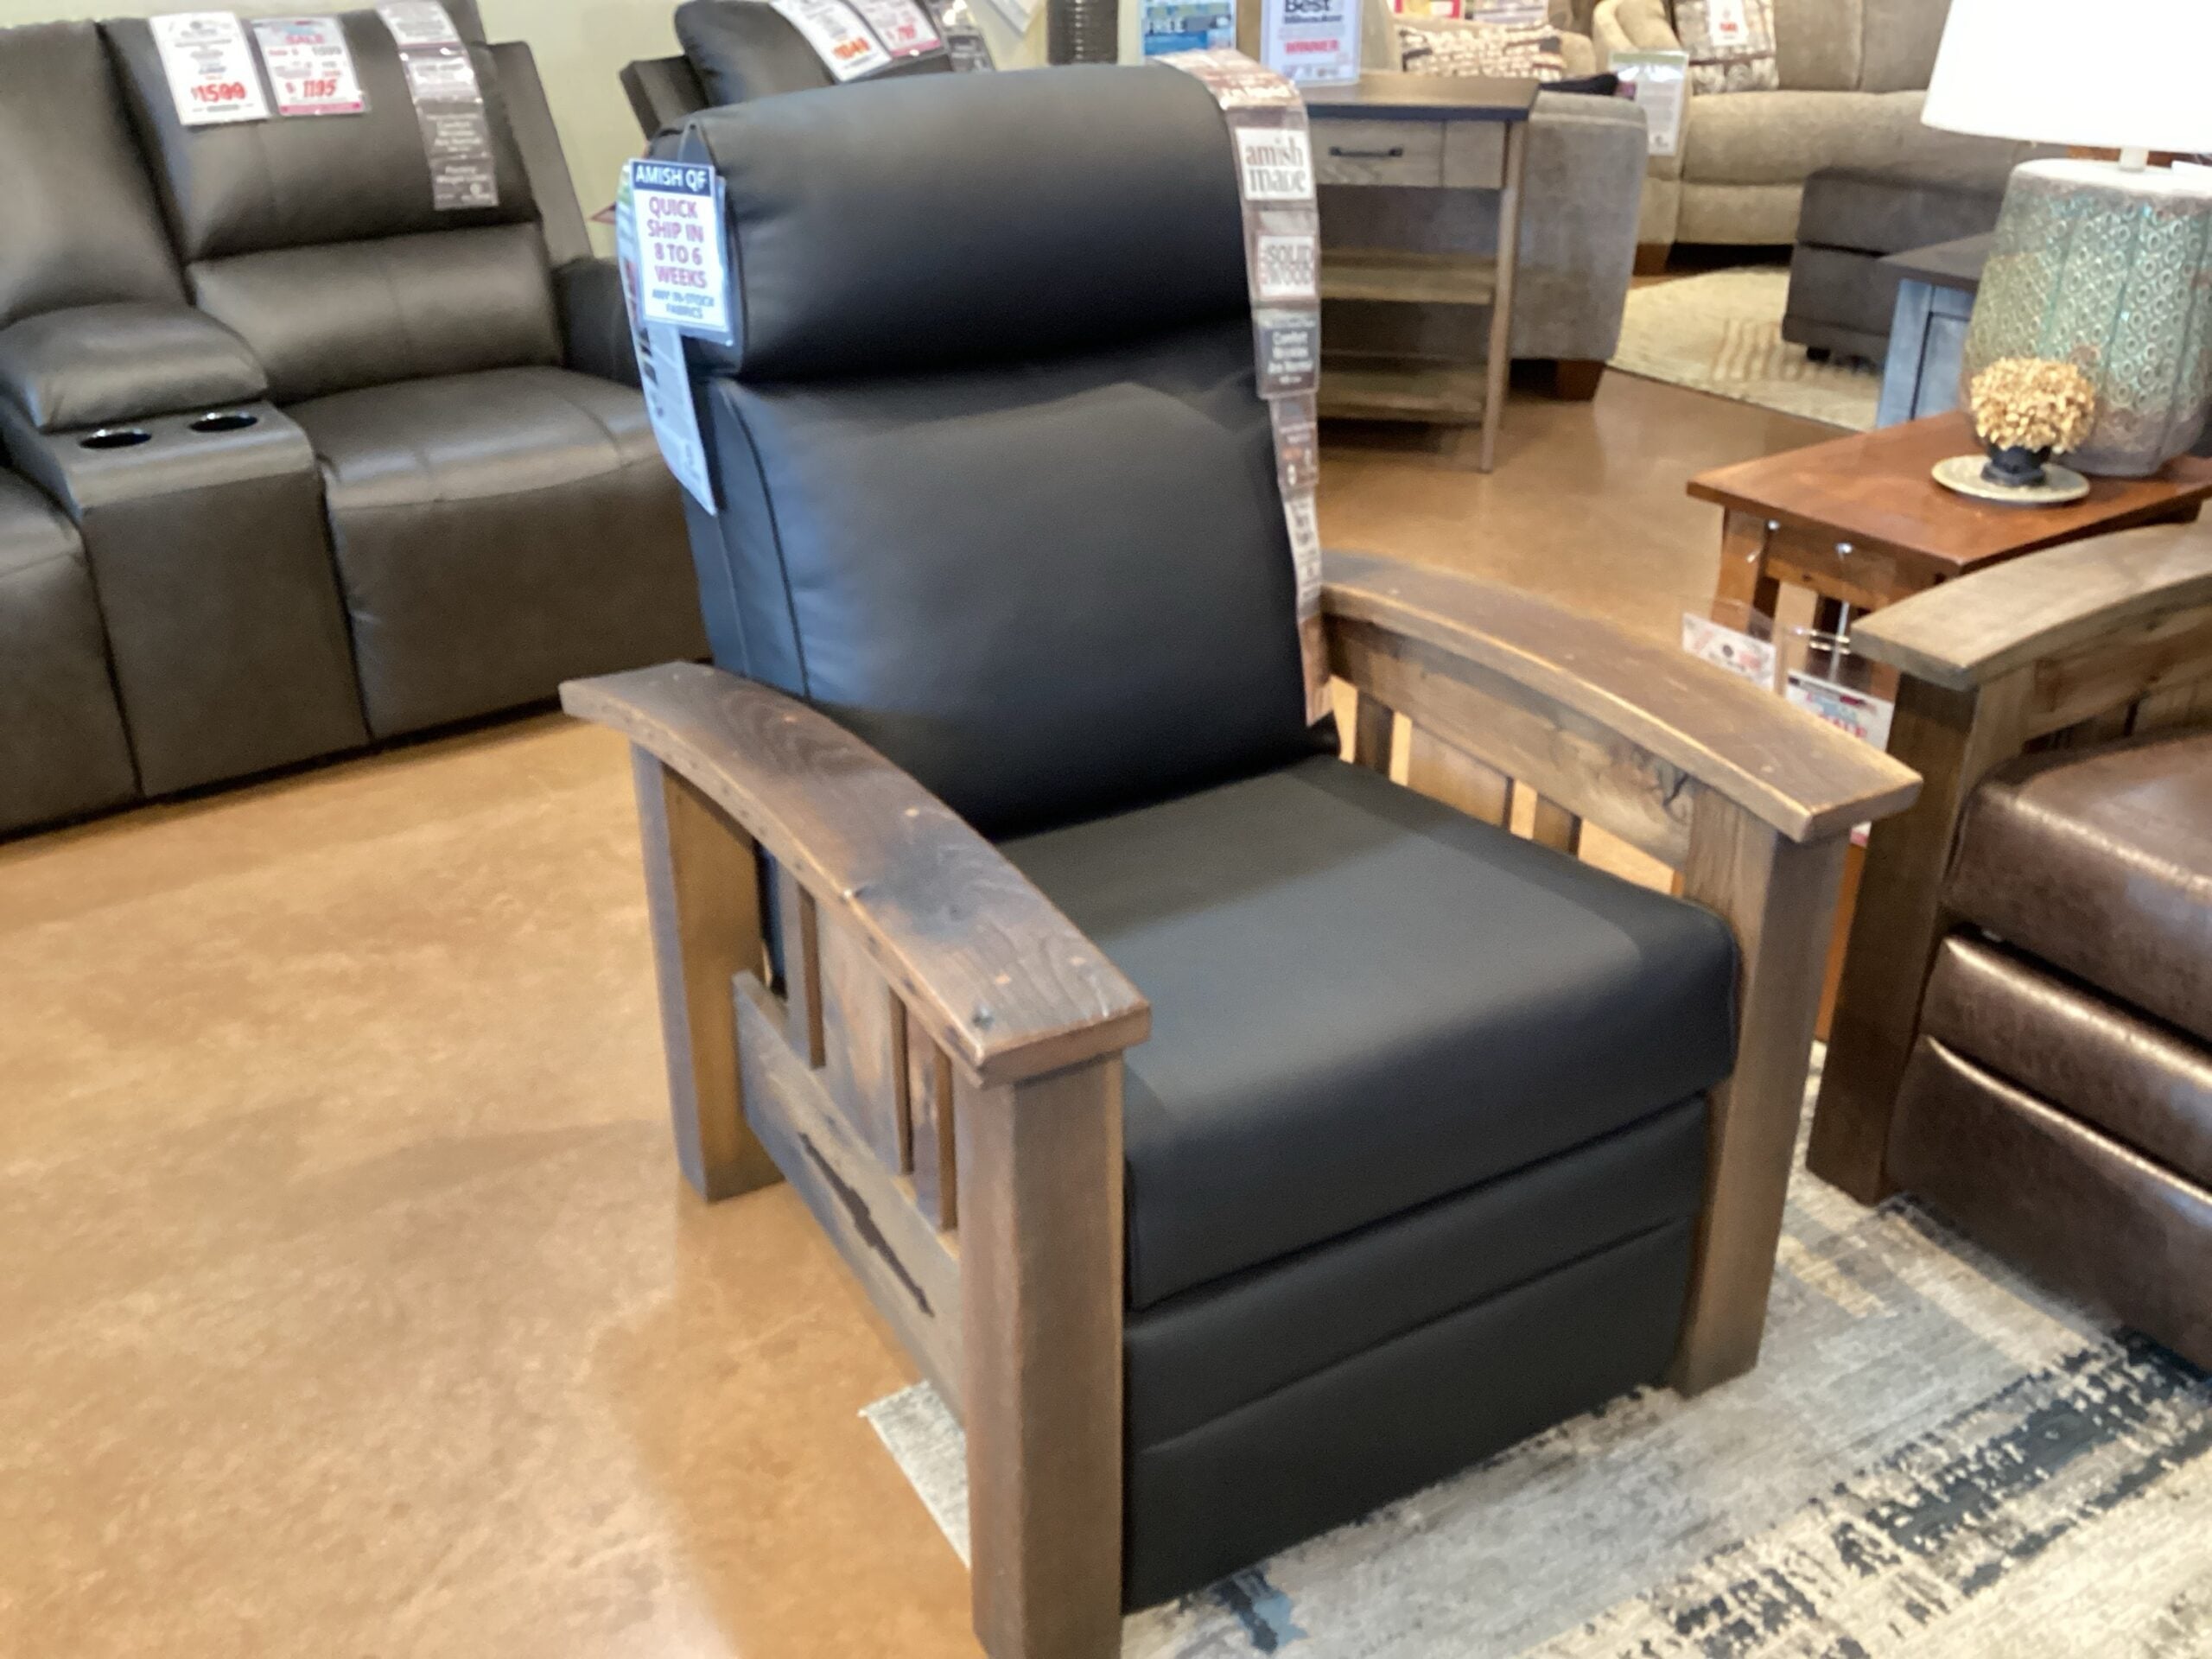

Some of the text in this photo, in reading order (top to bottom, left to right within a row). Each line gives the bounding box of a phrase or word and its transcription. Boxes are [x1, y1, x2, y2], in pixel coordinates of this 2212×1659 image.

[635, 164, 683, 188] AMISH
[649, 196, 699, 219] QUICK
[647, 219, 704, 243] SHIP IN
[666, 244, 689, 264] TO
[691, 247, 703, 266] 6
[654, 265, 709, 289] WEEKS
